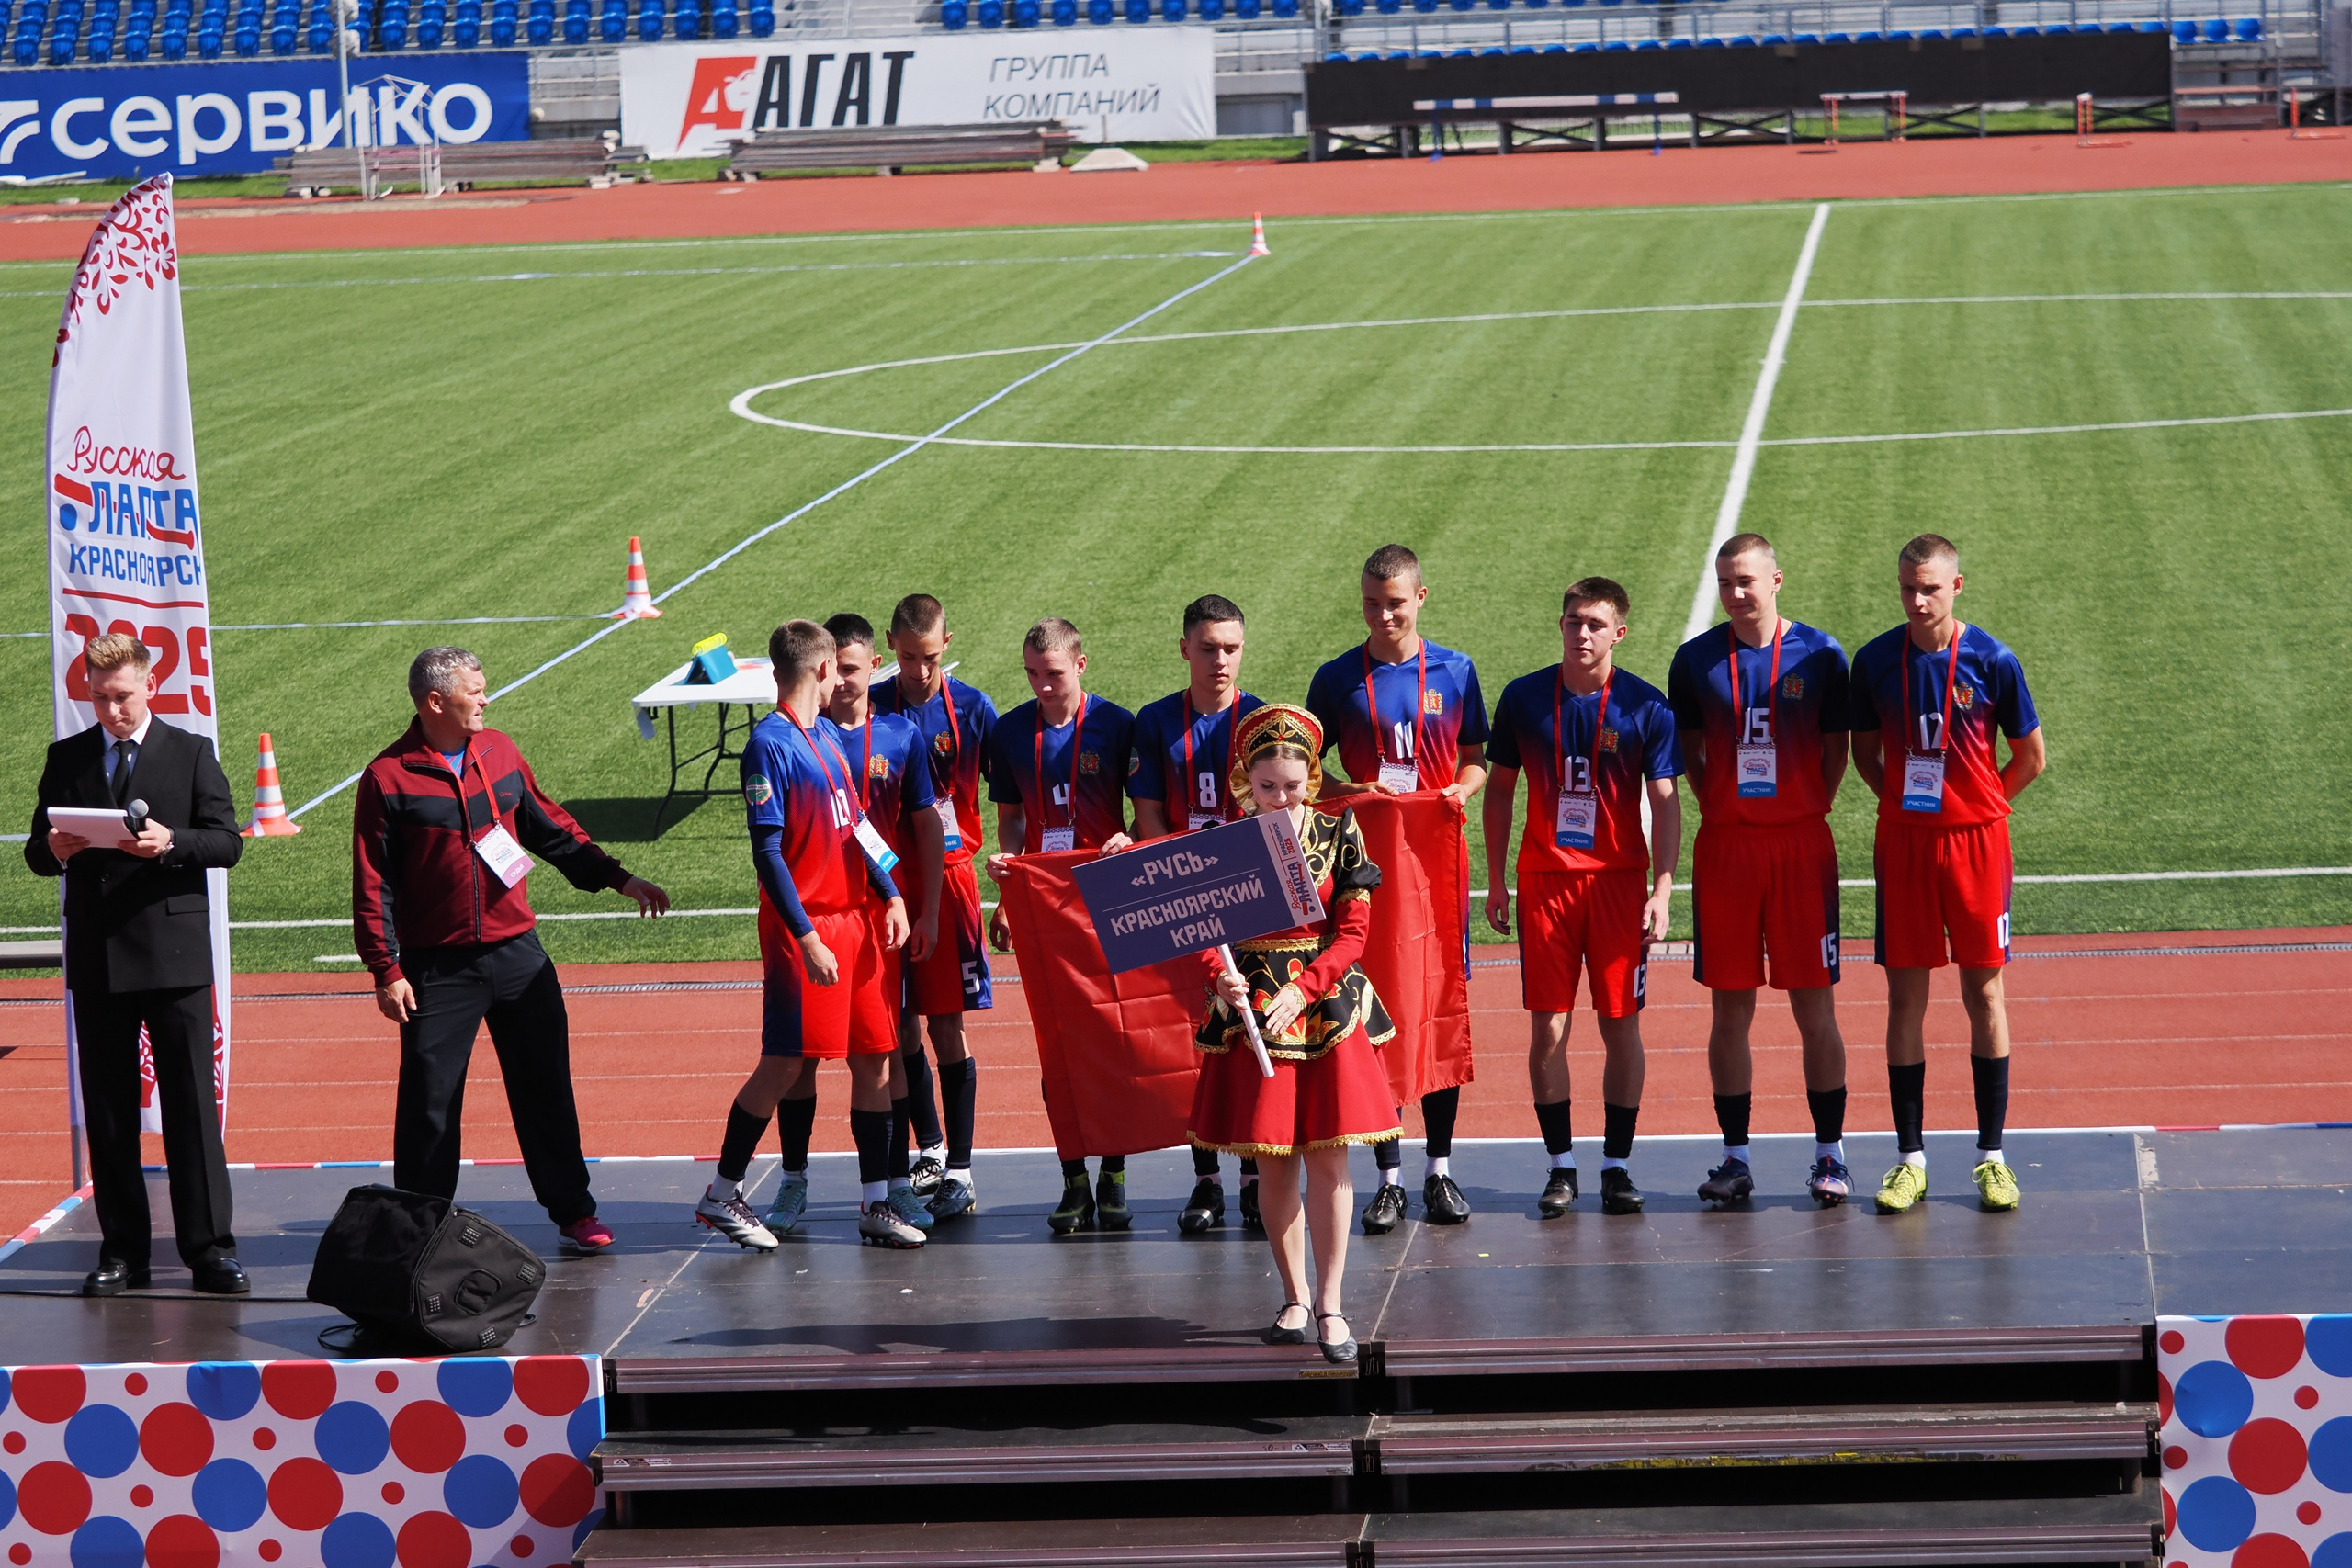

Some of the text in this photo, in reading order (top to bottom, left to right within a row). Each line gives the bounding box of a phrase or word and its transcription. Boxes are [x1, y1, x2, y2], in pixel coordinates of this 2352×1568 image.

[989, 52, 1110, 83] ГРУППА
[752, 51, 917, 128] АГАТ
[983, 82, 1161, 120] КОМПАНИЙ
[50, 82, 492, 165] сервико
[67, 425, 187, 482] Русская
[1394, 721, 1413, 759] 11
[1743, 707, 1770, 744] 15
[1199, 772, 1216, 807] 8
[1564, 755, 1591, 792] 13
[1052, 783, 1076, 818] 4
[1272, 822, 1288, 856] КРАСНОЯРСК
[1131, 851, 1219, 886] «РУСЬ»
[1110, 874, 1266, 936] КРАСНОЯРСКИЙ
[1170, 913, 1226, 948] КРАЙ
[1820, 932, 1837, 968] 15
[961, 960, 980, 994] 5
[1633, 964, 1646, 998] 13
